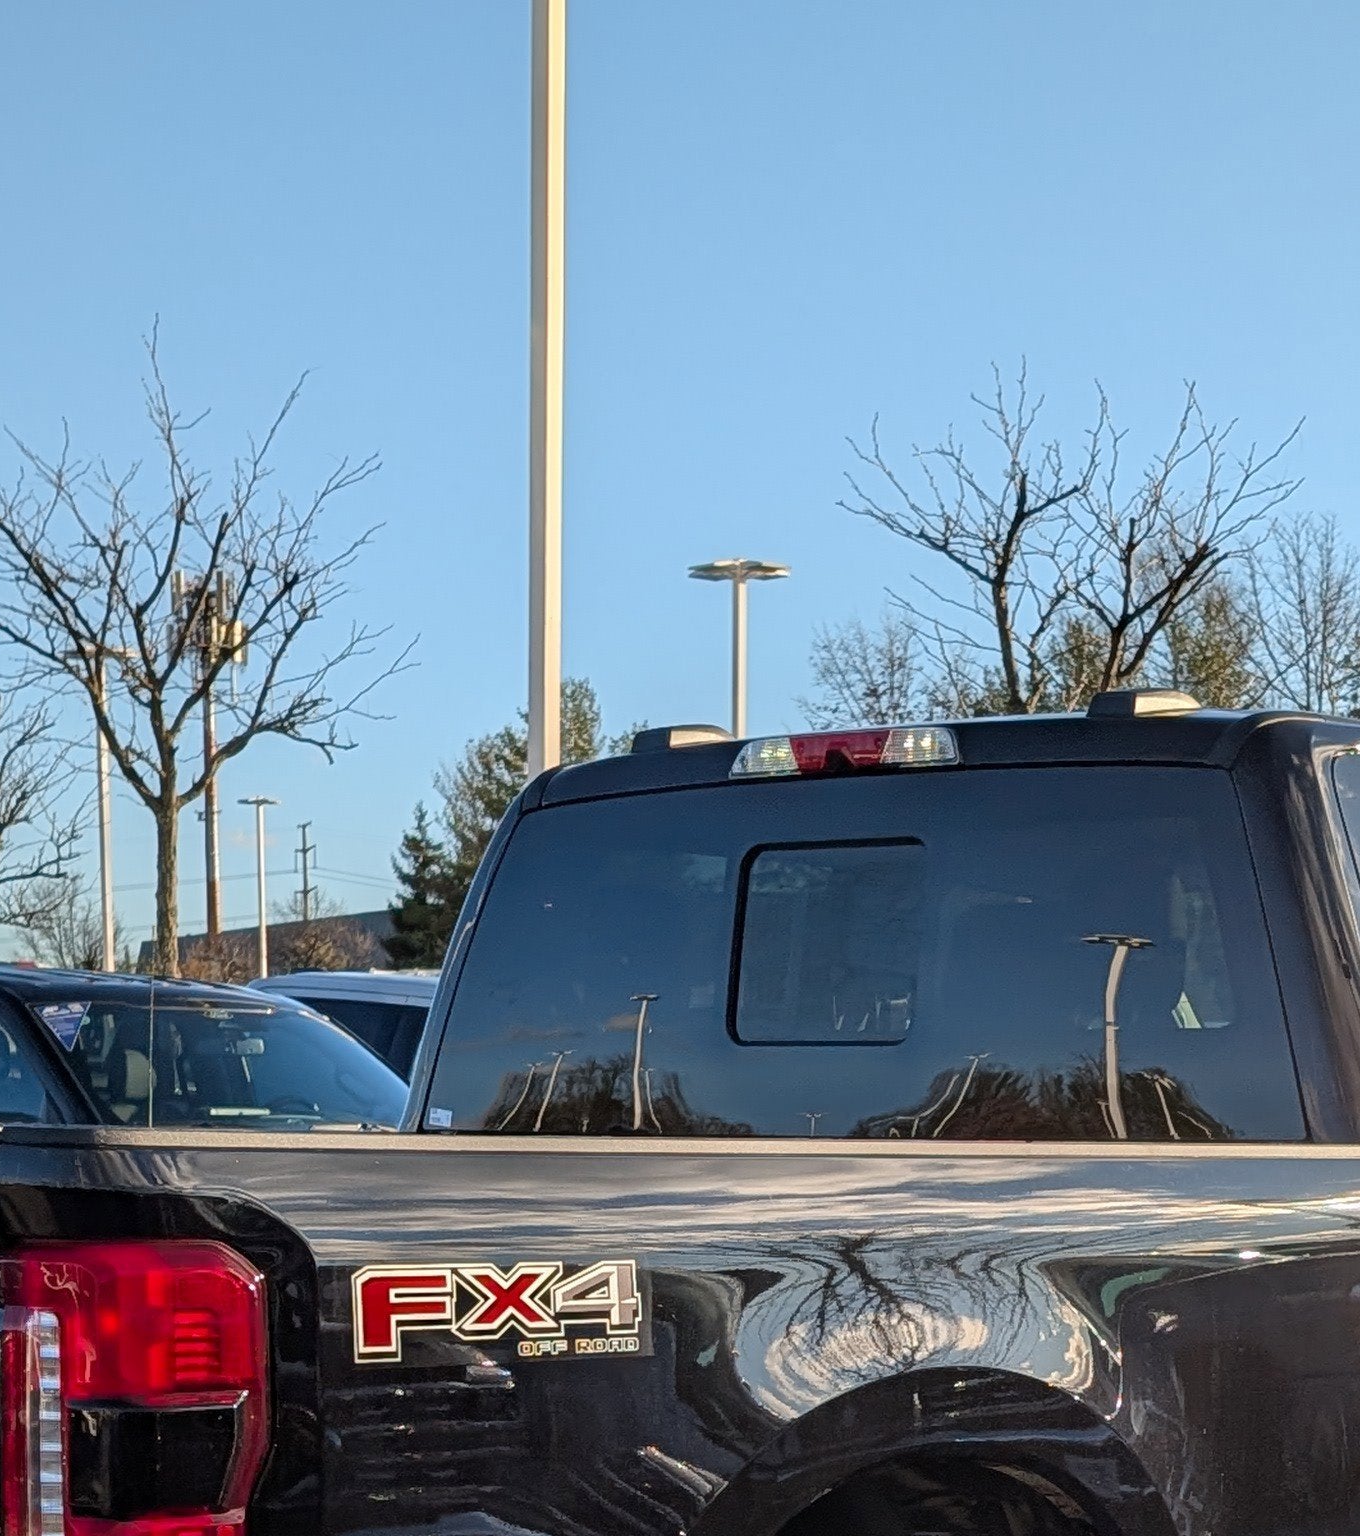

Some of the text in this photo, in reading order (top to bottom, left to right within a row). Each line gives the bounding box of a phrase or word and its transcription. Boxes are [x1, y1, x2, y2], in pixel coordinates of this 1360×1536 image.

[352, 1260, 643, 1363] FX4
[517, 1337, 640, 1357] OFF ROAD
